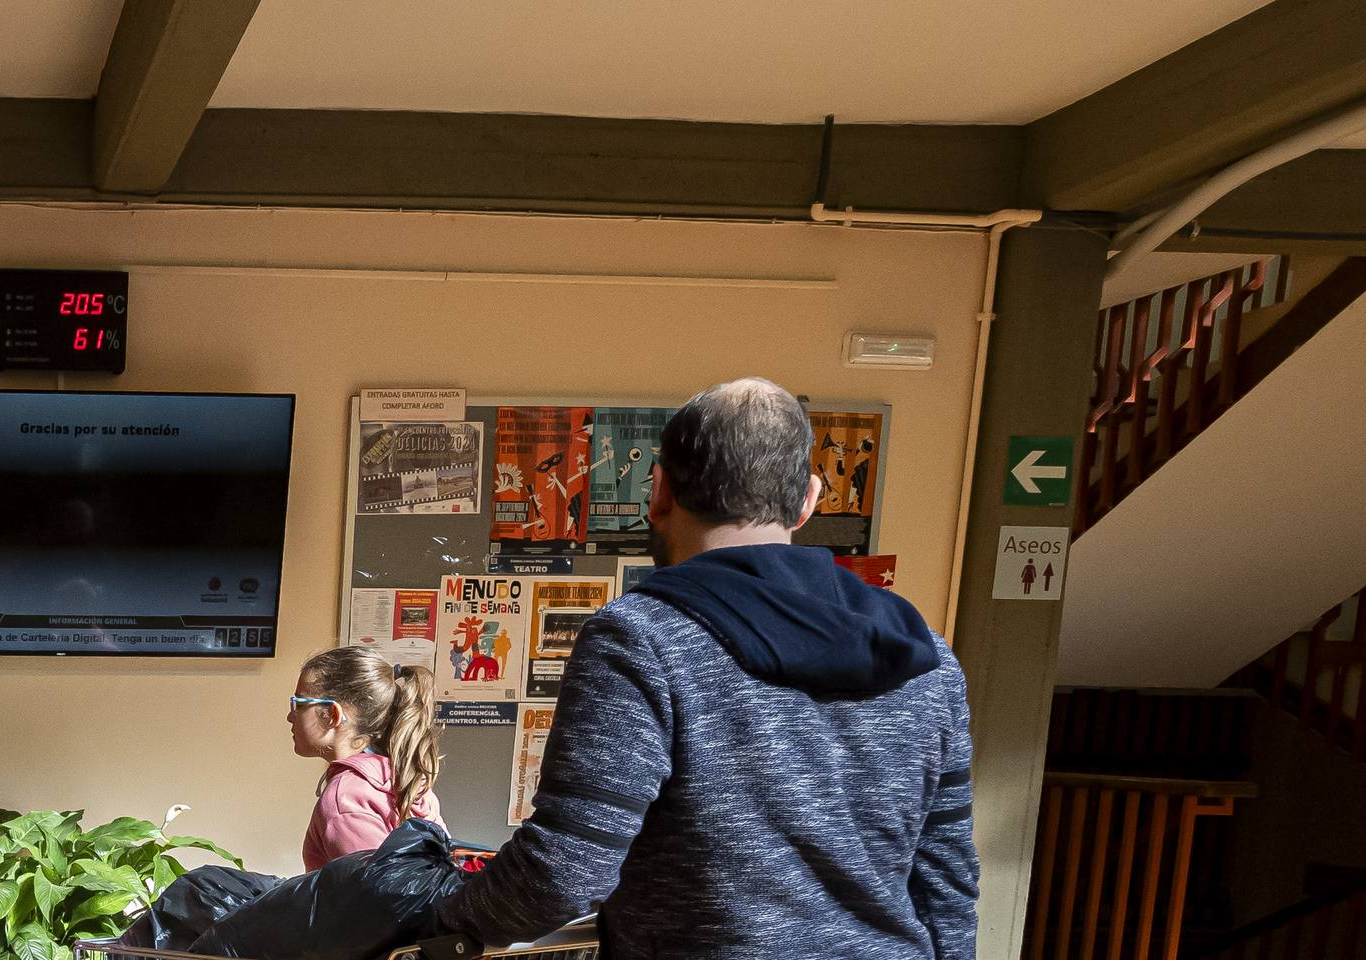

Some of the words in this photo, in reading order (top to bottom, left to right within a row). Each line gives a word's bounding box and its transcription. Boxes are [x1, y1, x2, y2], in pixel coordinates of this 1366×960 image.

[74, 329, 104, 350] 61
[367, 391, 401, 399] ENTRADAS
[402, 391, 438, 399] GRATUITAS
[381, 402, 421, 410] COMPLETAR
[422, 402, 444, 410] AFORO
[20, 422, 70, 434] Gracias
[74, 424, 97, 438] por
[101, 424, 117, 435] su
[121, 423, 180, 436] atención
[397, 437, 446, 451] DELICIAS
[1003, 536, 1062, 554] Aseos
[514, 565, 548, 573] TEATRO
[446, 578, 522, 601] MENUDO
[106, 617, 138, 625] GENERAL
[5, 632, 17, 642] de
[112, 633, 142, 645] Tenga
[145, 634, 158, 644] un
[161, 633, 186, 644] buen
